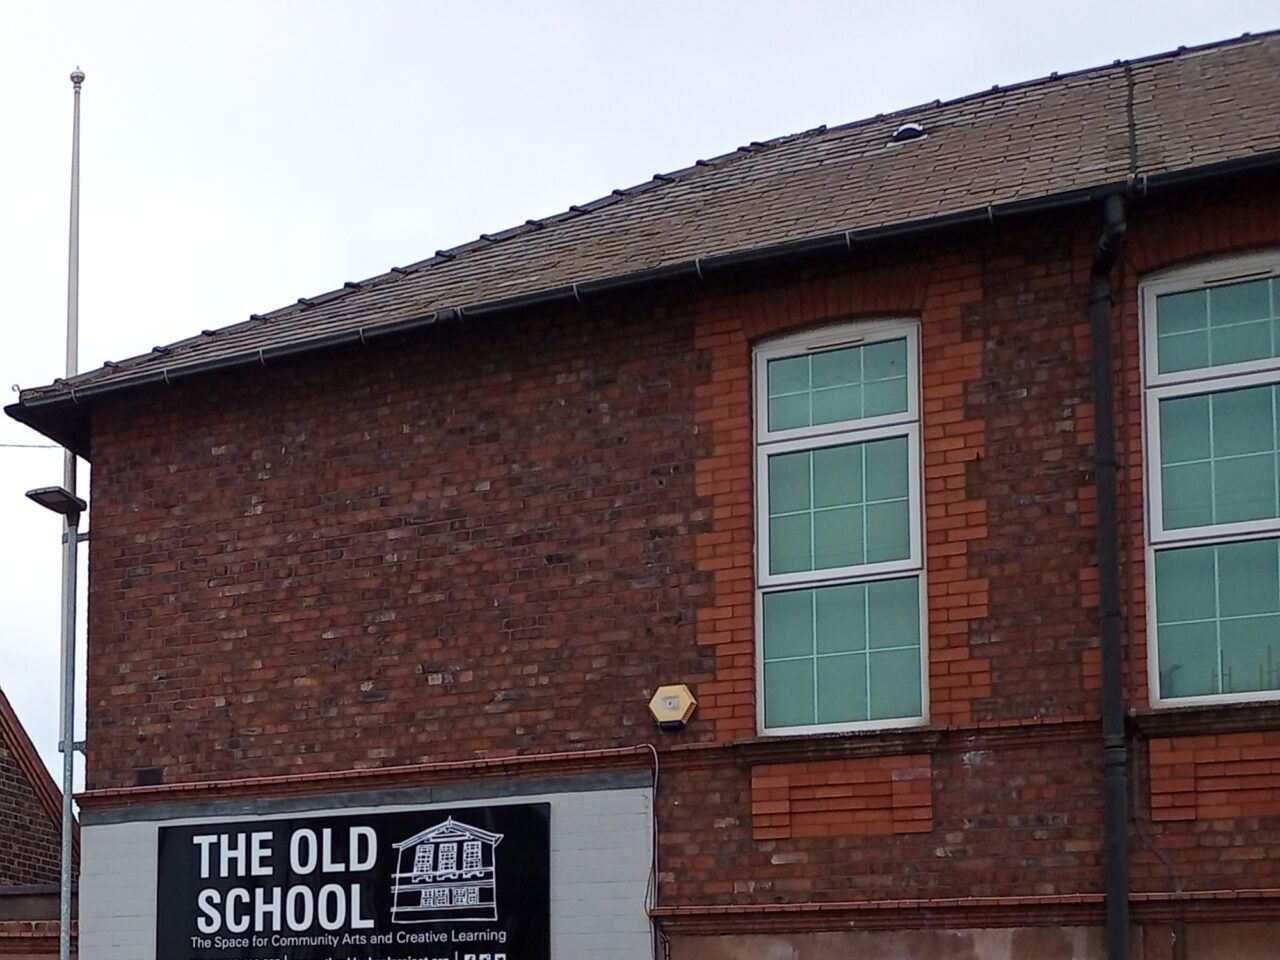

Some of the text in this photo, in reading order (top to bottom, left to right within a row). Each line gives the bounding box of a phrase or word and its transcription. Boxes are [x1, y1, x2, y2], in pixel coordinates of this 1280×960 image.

[193, 826, 378, 878] THE OLD
[197, 883, 375, 934] SCHOOL
[190, 929, 507, 950] The Space for Community Arts and Creative Learning
